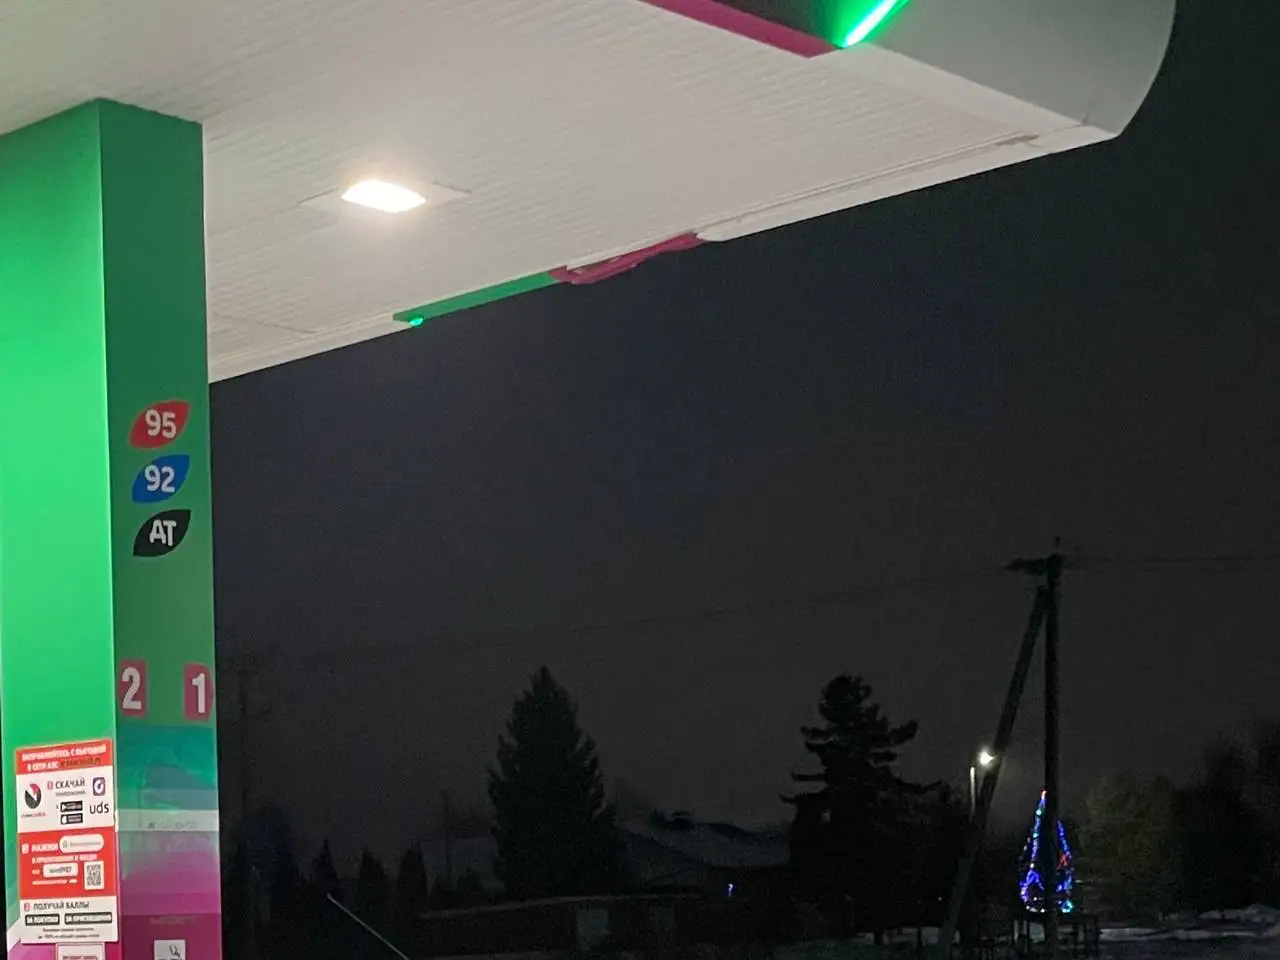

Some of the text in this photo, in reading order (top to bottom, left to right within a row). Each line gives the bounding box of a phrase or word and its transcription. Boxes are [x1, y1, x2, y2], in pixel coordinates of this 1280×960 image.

[145, 409, 177, 440] 95
[144, 465, 176, 493] 92
[121, 667, 142, 710] 2
[192, 673, 206, 713] 1
[55, 778, 86, 789] СКАЧАЙ
[89, 802, 110, 814] uds
[33, 901, 65, 911] ПОЛУЧАЙ
